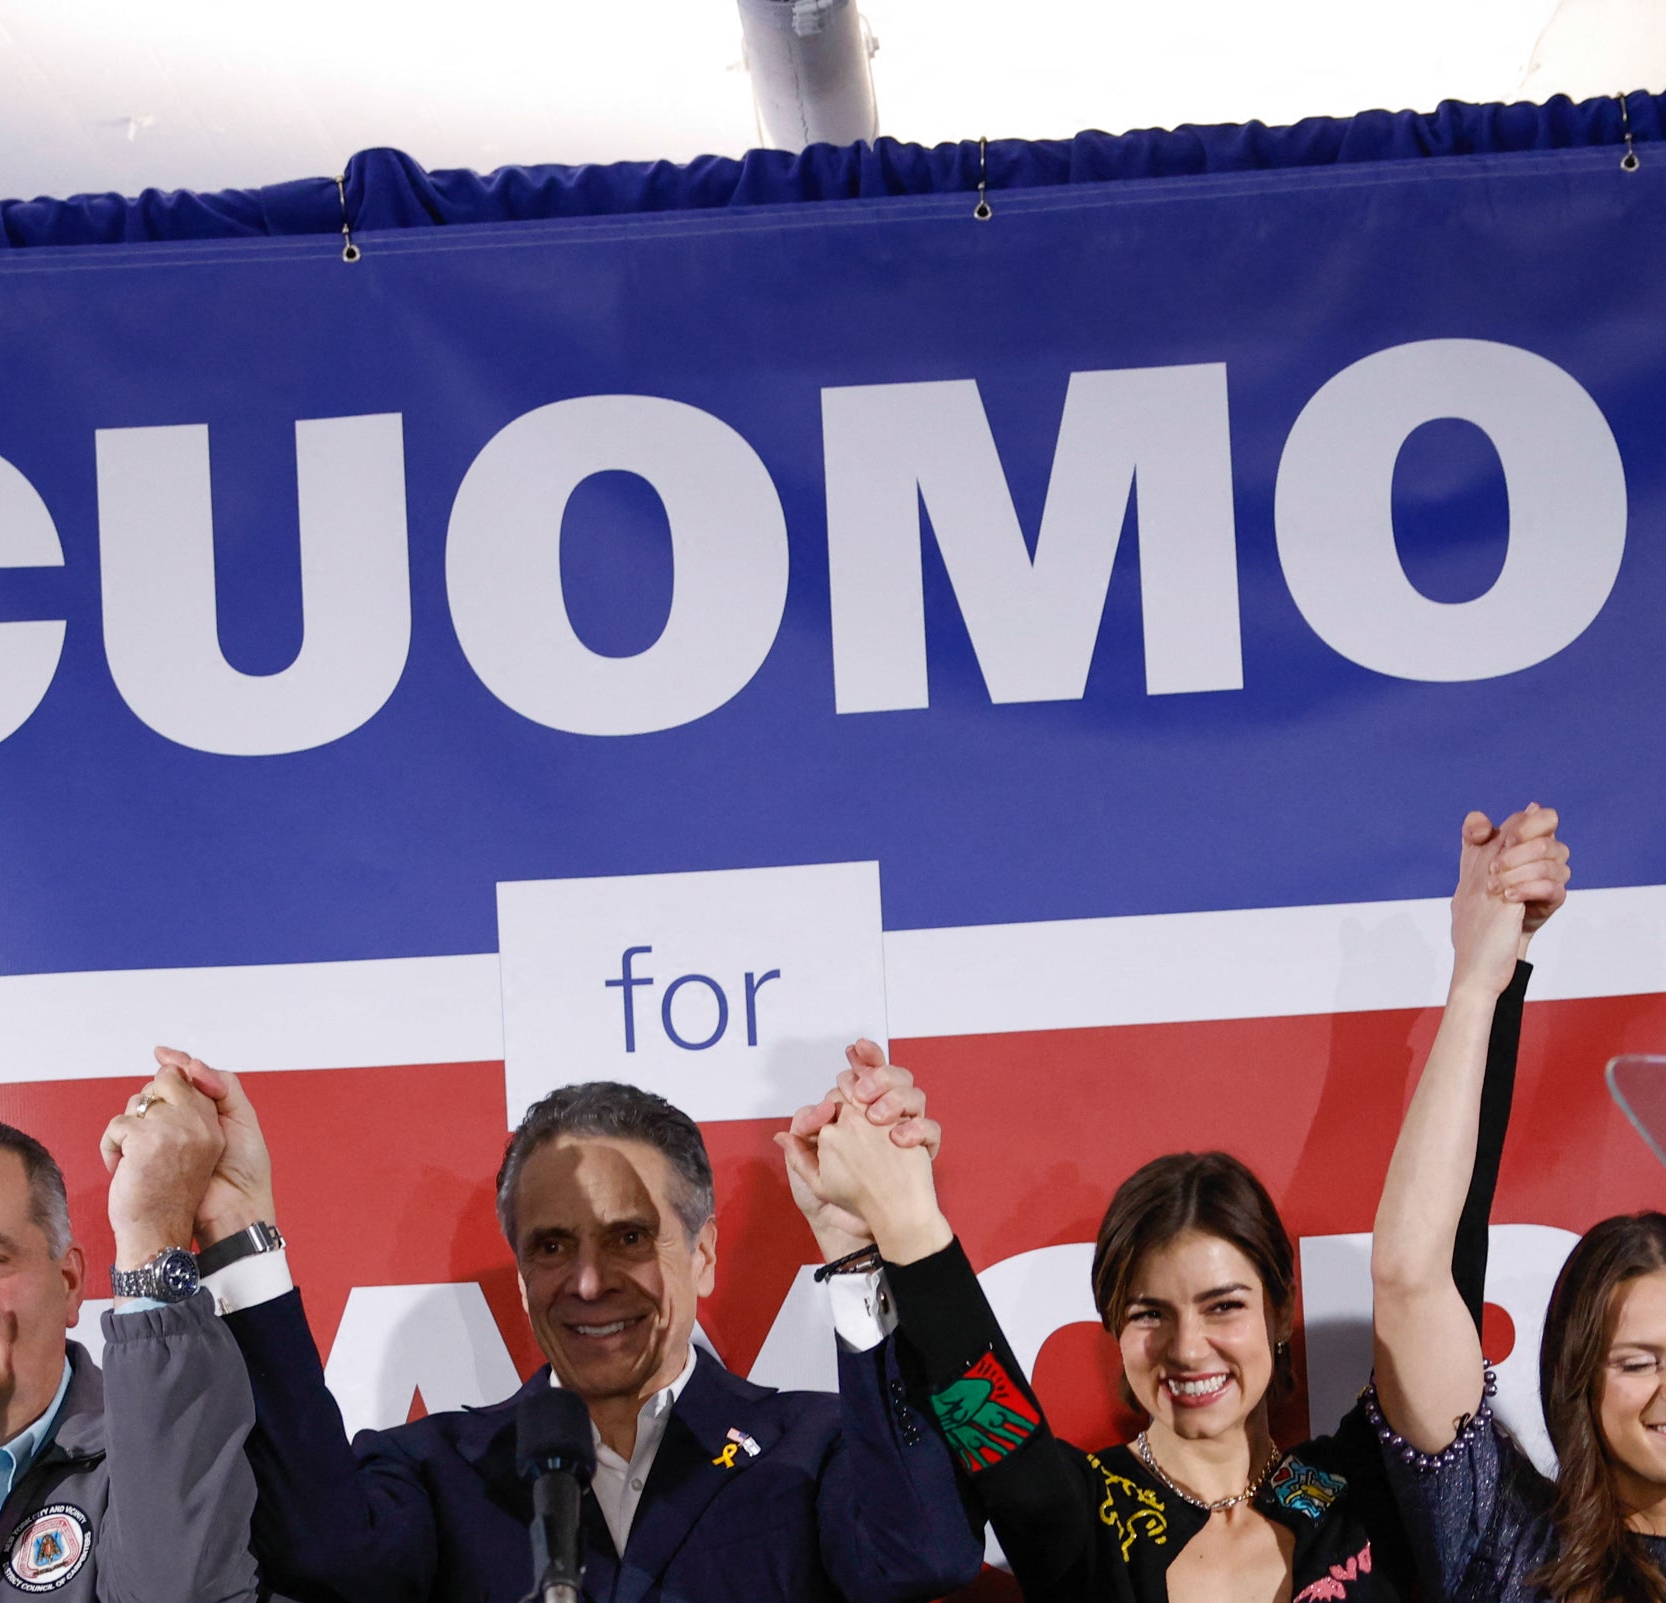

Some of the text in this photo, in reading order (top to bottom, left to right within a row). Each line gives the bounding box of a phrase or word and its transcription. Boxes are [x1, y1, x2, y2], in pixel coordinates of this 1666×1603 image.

[606, 945, 782, 1055] for
[12, 1516, 32, 1536] YORK
[32, 1507, 49, 1521] CITY
[49, 1505, 65, 1514] AND
[66, 1505, 87, 1524] VICINITY
[3, 1562, 22, 1586] DISTRICT
[21, 1583, 55, 1592] COUNCIL
[55, 1578, 67, 1587] OF
